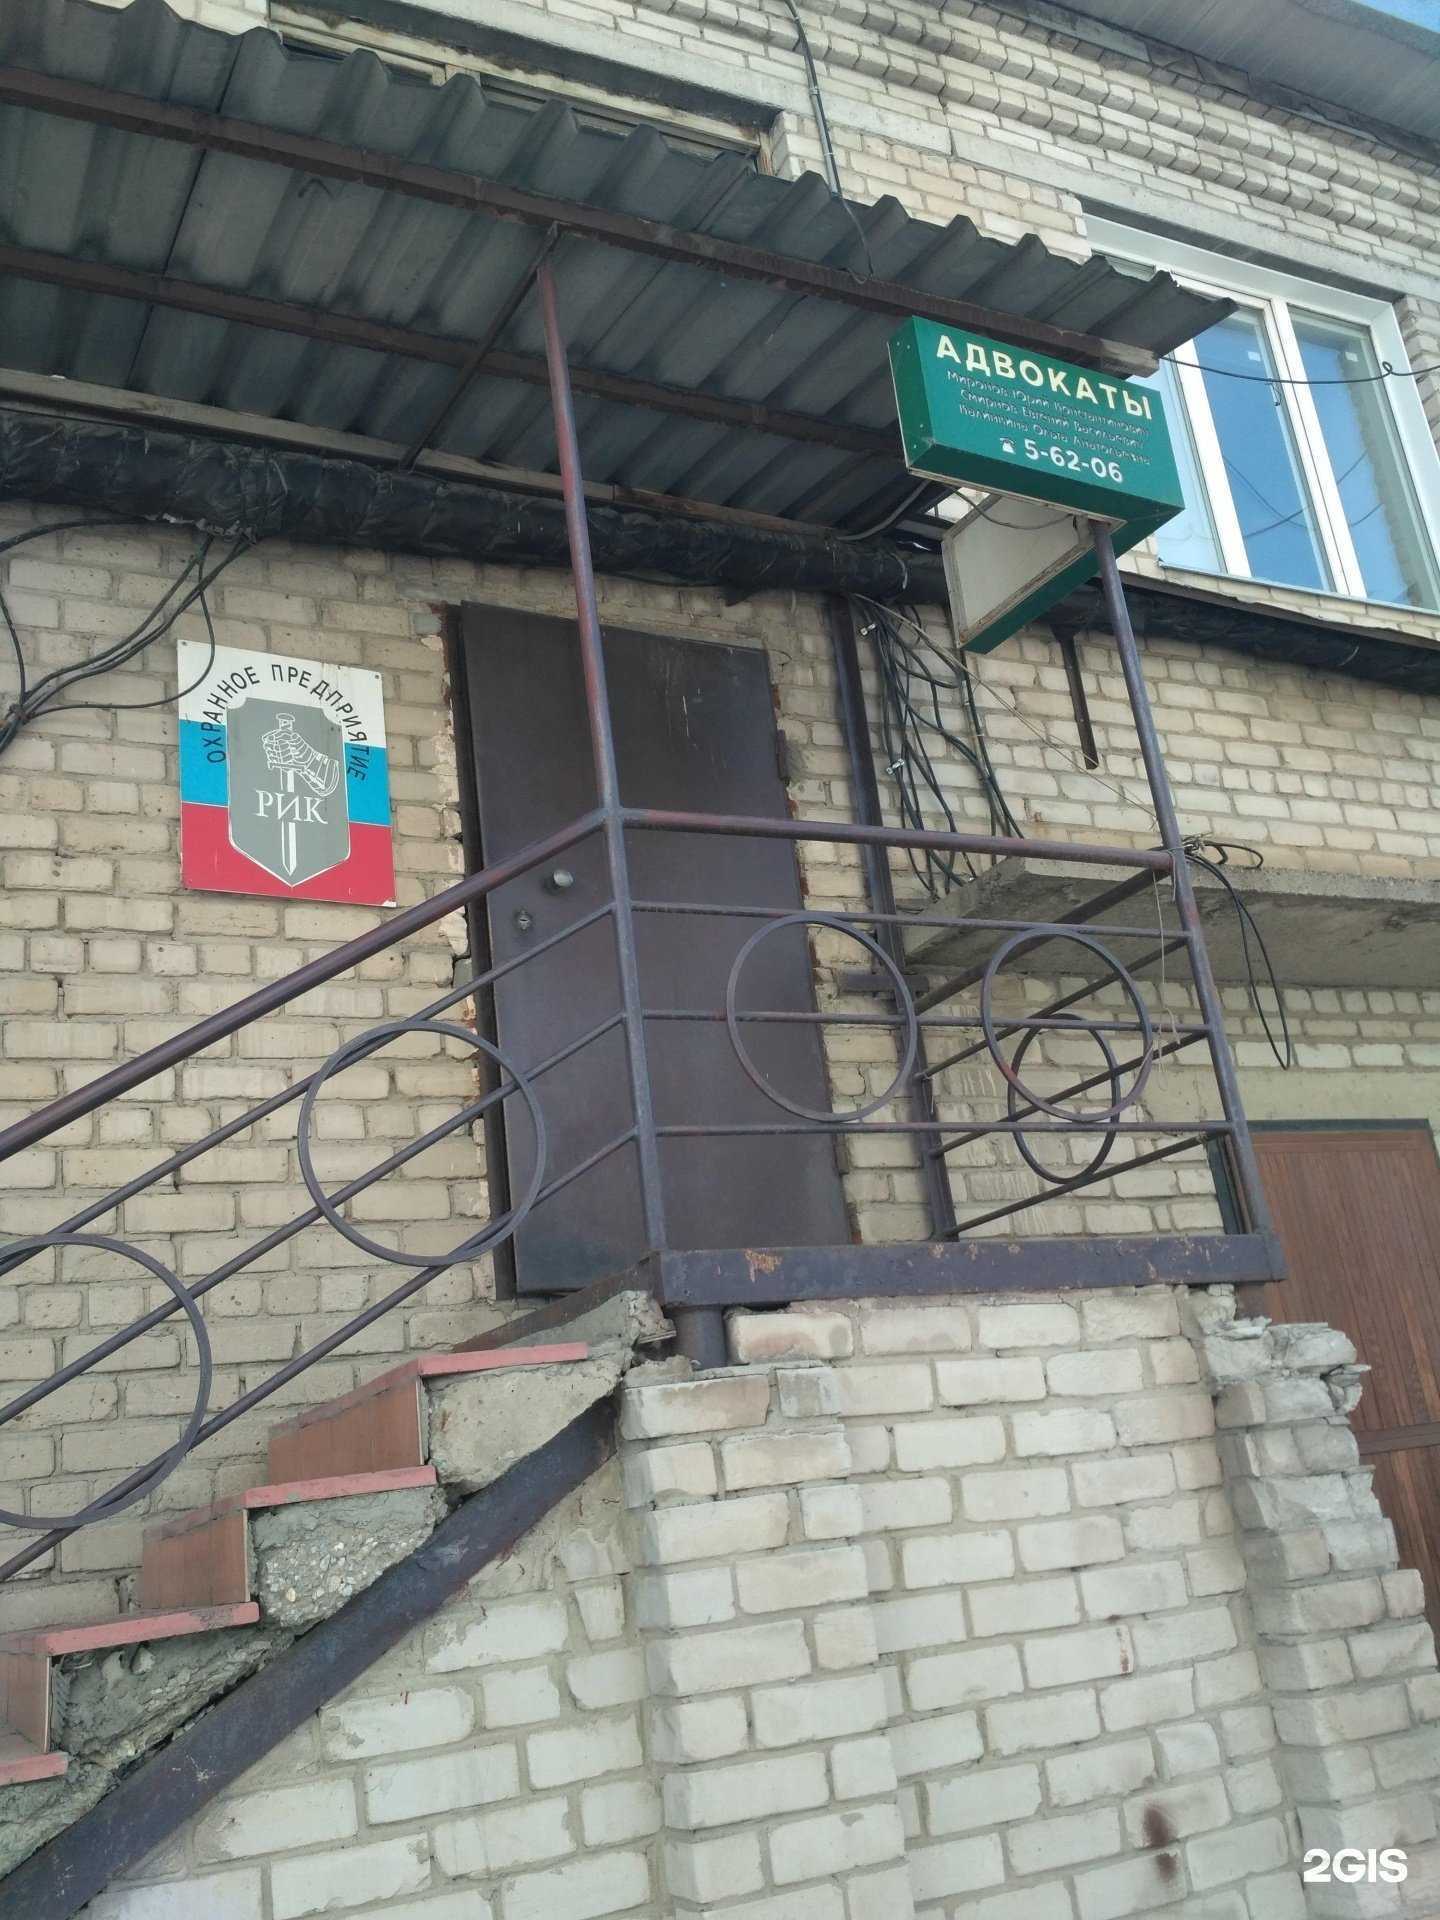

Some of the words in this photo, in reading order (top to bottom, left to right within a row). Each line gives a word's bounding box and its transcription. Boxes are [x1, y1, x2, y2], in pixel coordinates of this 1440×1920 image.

[936, 335, 1153, 420] АДВОКАТЫ
[1024, 438, 1123, 483] 5-62-06
[201, 666, 260, 764] ОХРАННОЕ
[271, 664, 370, 781] ПРЕДПРИЯТИЕ
[255, 790, 328, 824] РИК
